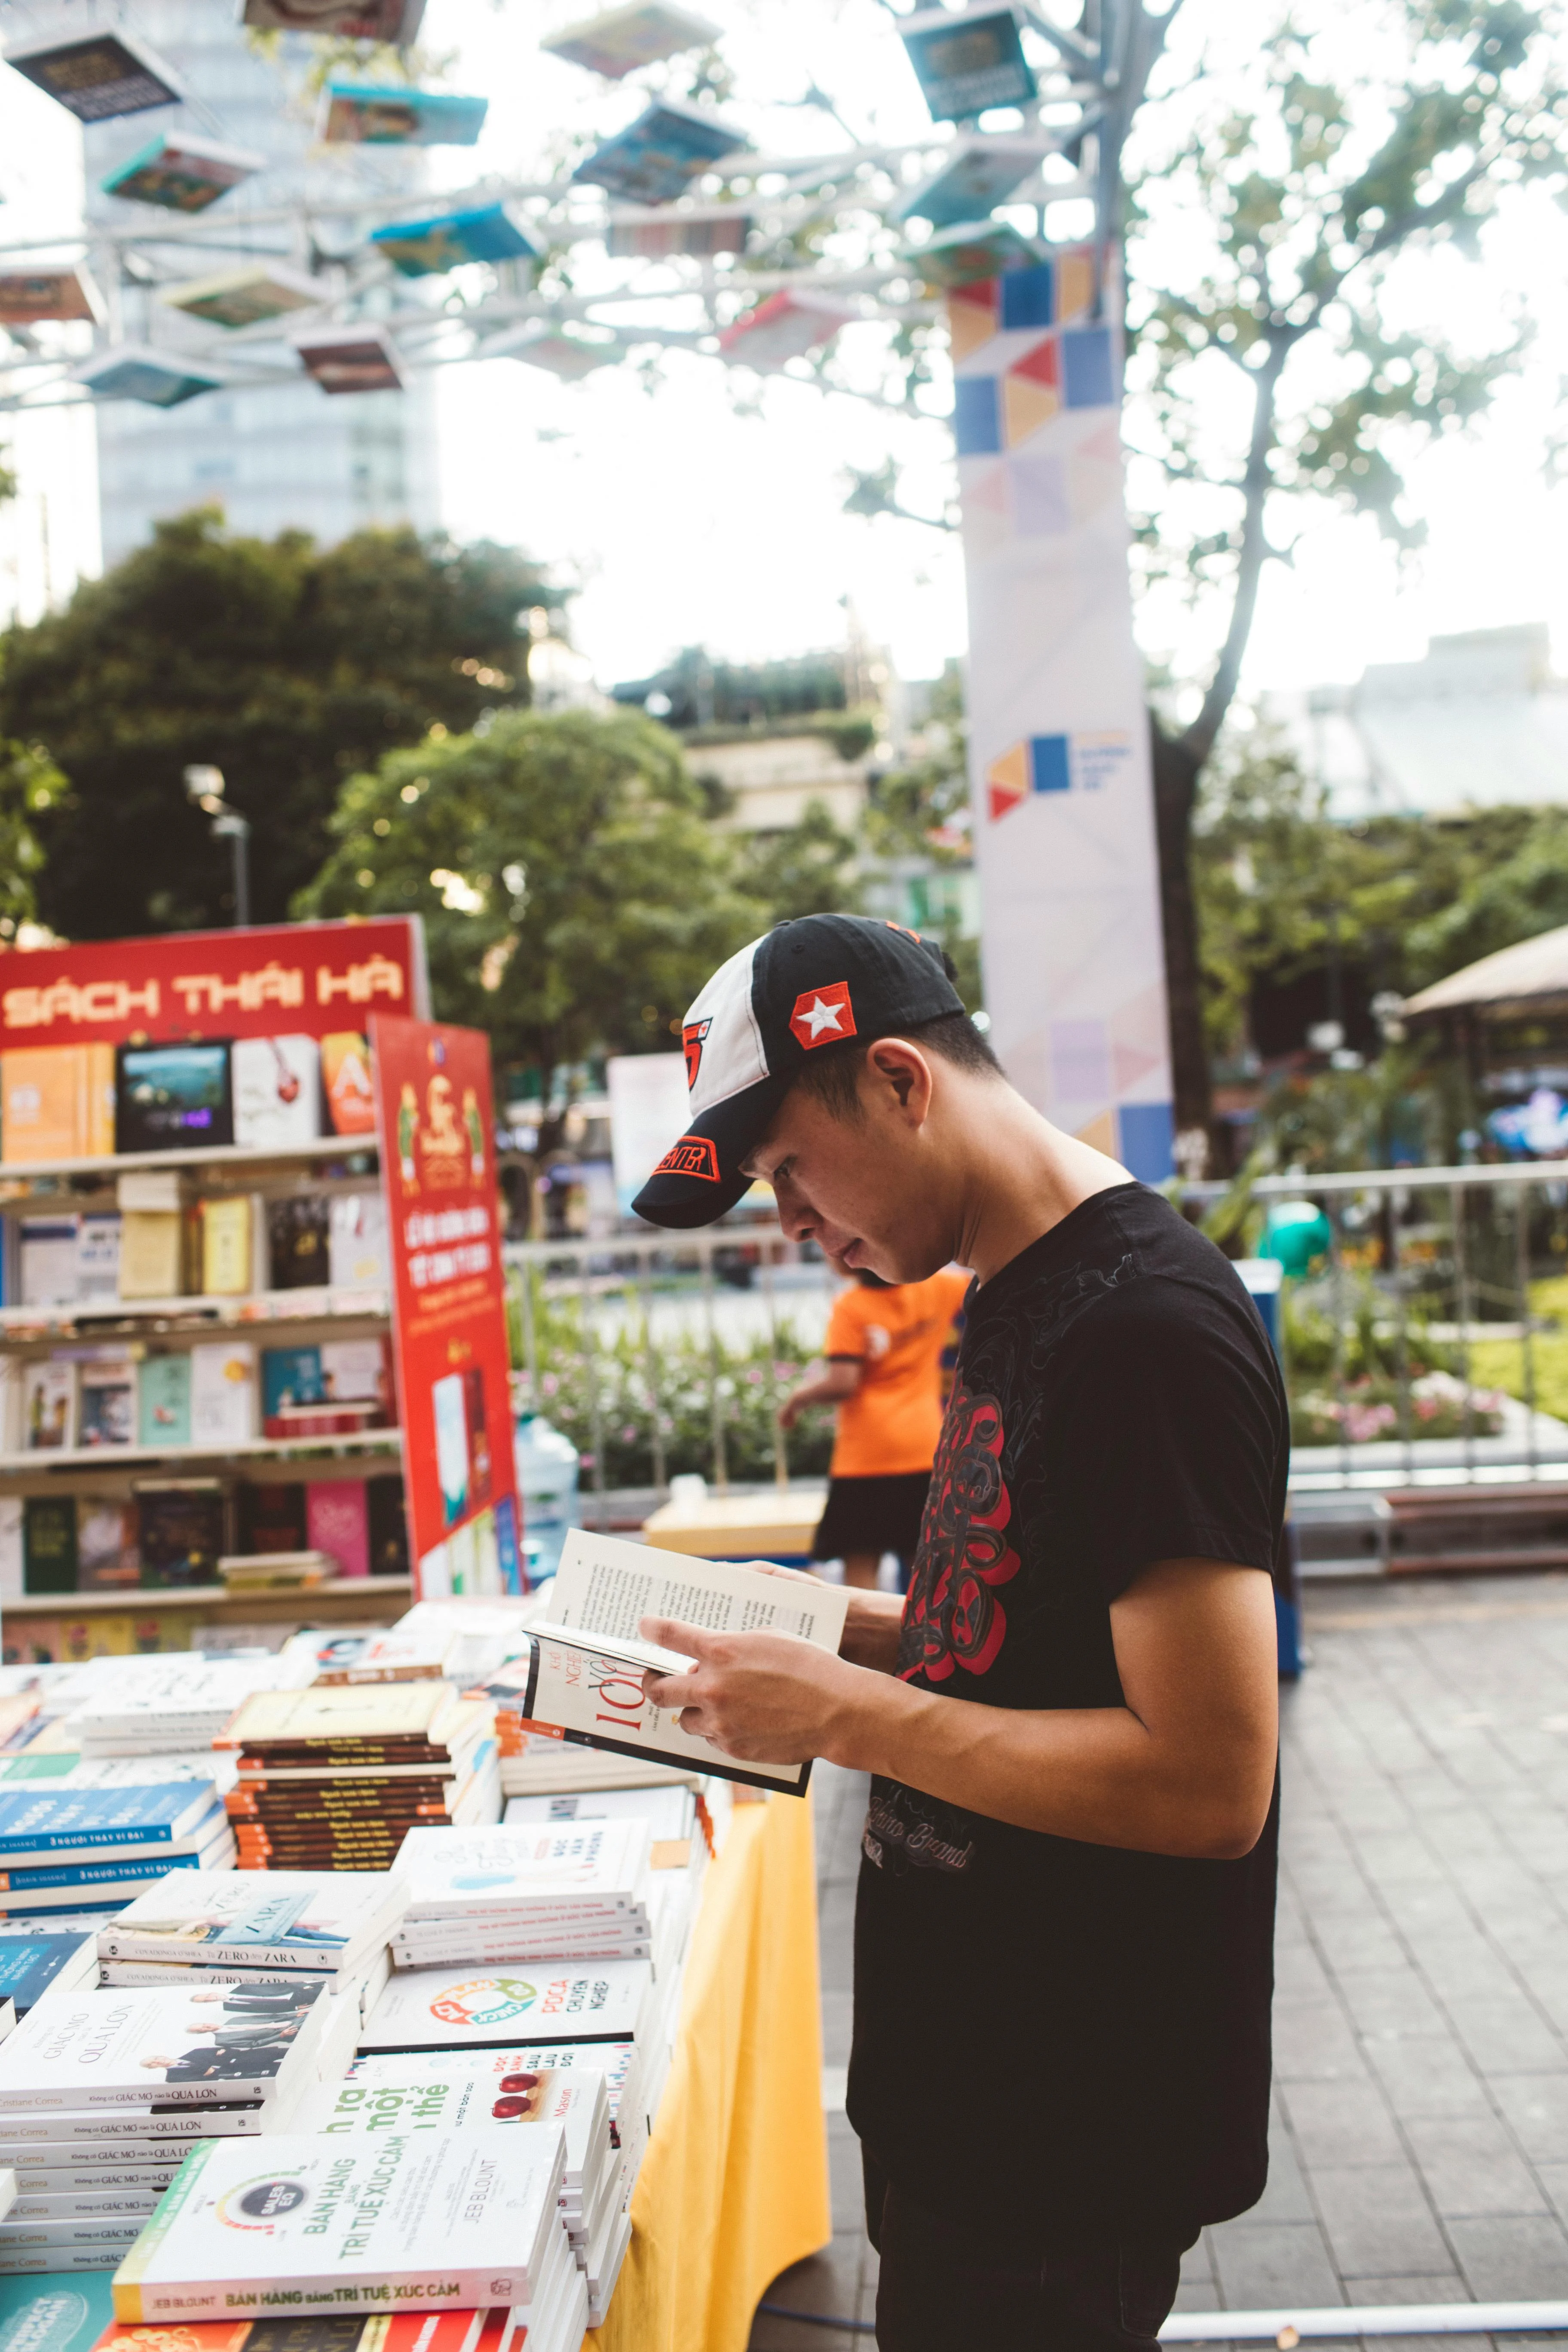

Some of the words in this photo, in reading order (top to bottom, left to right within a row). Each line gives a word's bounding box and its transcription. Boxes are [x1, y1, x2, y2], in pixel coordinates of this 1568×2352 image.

[2, 976, 160, 1028] SÁCH
[172, 960, 304, 1015] THÁI
[316, 952, 404, 1006] HÀ
[217, 1950, 249, 1961] ZERO
[263, 1953, 298, 1964] ZARA
[210, 1974, 242, 1984] ZERO
[442, 1980, 490, 2000] PLAN
[541, 1978, 570, 2014] PDCA
[478, 2004, 524, 2023] CHECK
[35, 2097, 63, 2106] Correa
[172, 2089, 195, 2101] QUÁ
[334, 2089, 368, 2113] ra
[409, 2084, 450, 2117] thể
[554, 2089, 573, 2117] Mason
[364, 2088, 408, 2132] một
[20, 2128, 48, 2137] Correa
[156, 2121, 179, 2132] QUÁ
[16, 2155, 45, 2164] Correa
[19, 2179, 48, 2188] Correa
[469, 2159, 498, 2202] BLOUNT
[261, 2184, 287, 2216] SALES
[278, 2191, 297, 2207] EQ
[20, 2206, 49, 2216] Correa
[462, 2202, 484, 2224] JEB
[18, 2234, 48, 2243] Correa
[18, 2258, 47, 2267] Correa
[153, 2296, 171, 2309] JEB
[173, 2294, 217, 2308] BLOUNT
[260, 2288, 303, 2306] HÀNG
[334, 2285, 359, 2302] TRÍ
[393, 2283, 426, 2299] XÚC
